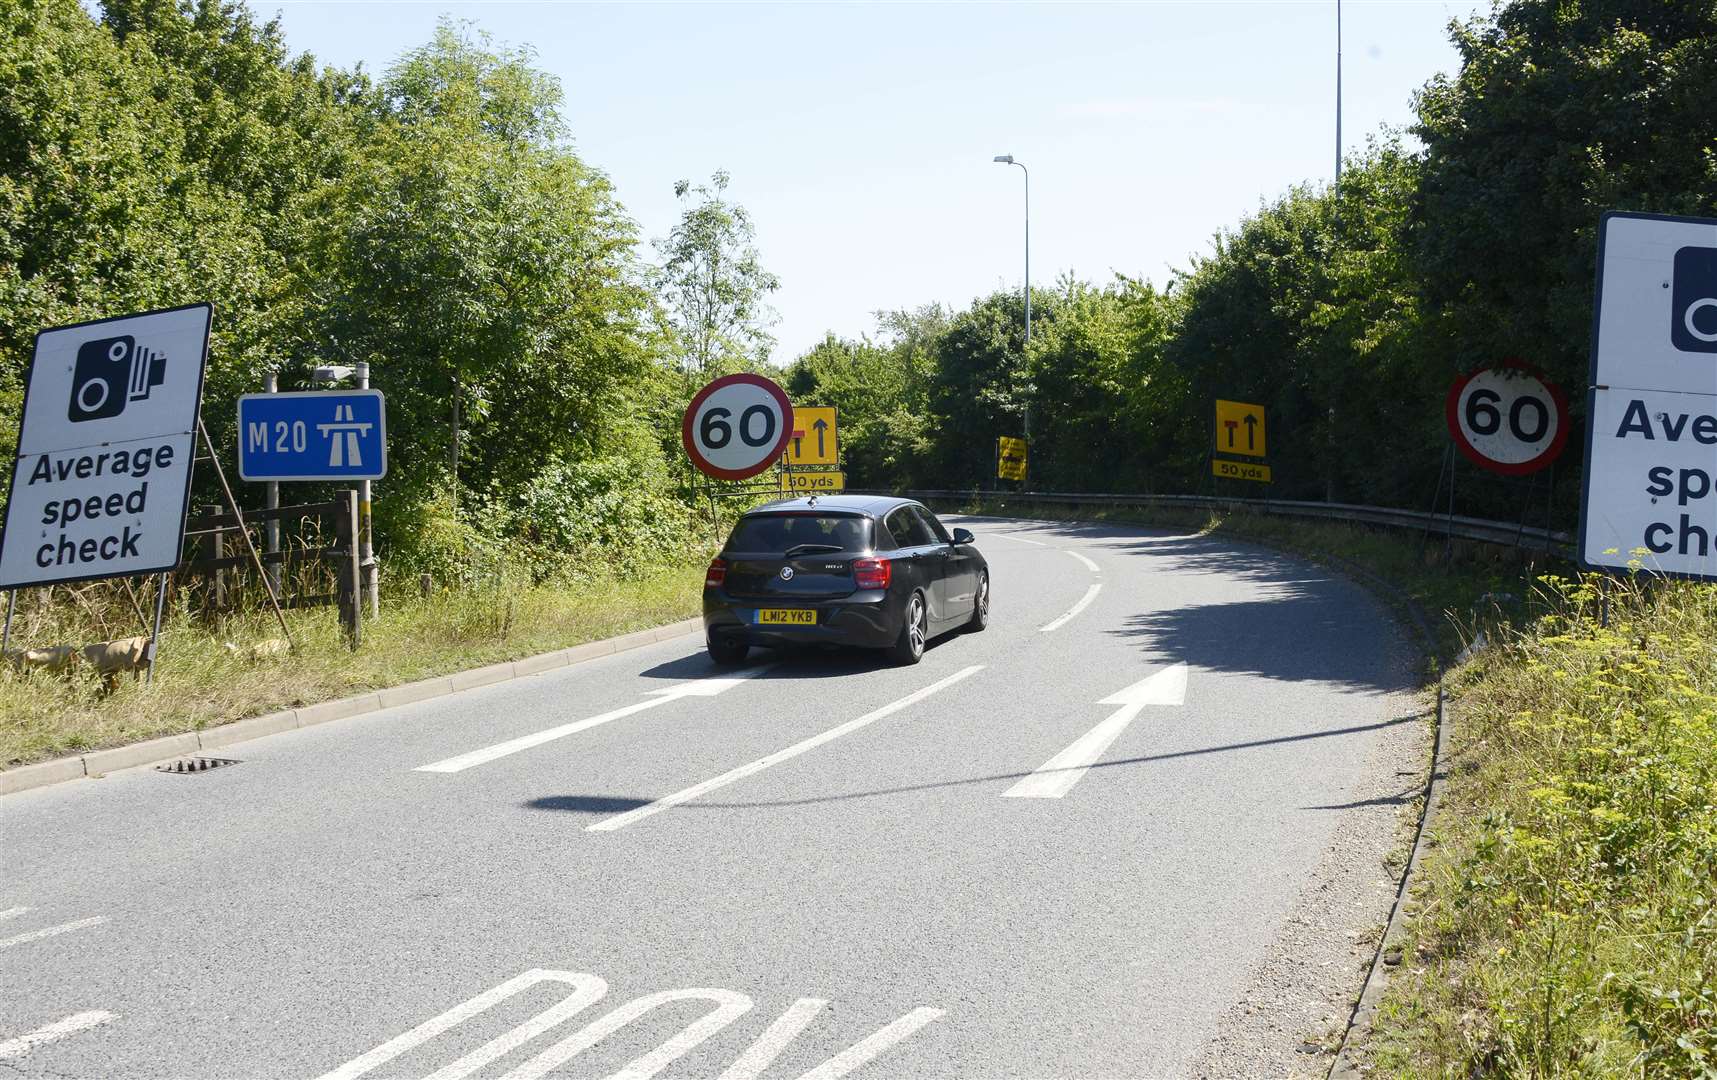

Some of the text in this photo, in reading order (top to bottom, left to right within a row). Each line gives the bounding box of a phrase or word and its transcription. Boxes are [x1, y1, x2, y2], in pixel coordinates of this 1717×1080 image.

[700, 404, 776, 450] 60
[1466, 389, 1549, 443] 60
[28, 444, 174, 486] Average
[788, 476, 834, 489] 50 yds
[1221, 463, 1263, 478] 50 yds
[1646, 466, 1717, 506] sp
[41, 481, 149, 529] speed
[36, 526, 142, 568] check
[1644, 513, 1717, 556] ch
[790, 610, 813, 622] YKB
